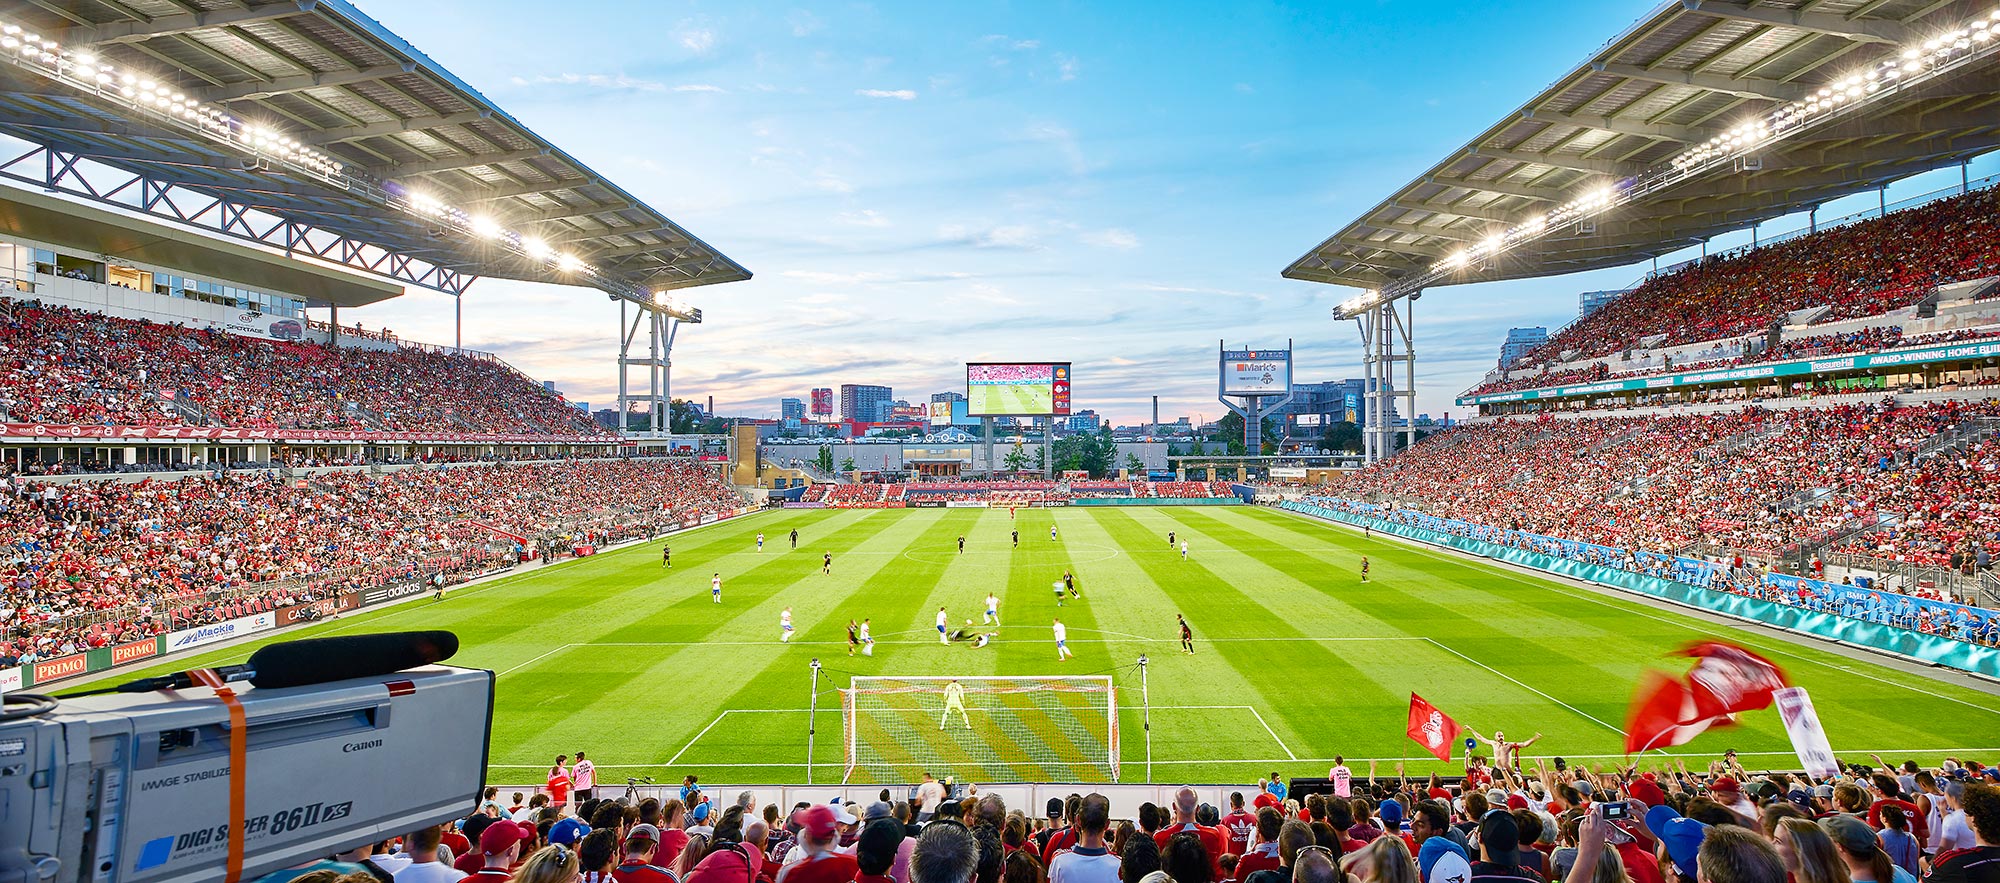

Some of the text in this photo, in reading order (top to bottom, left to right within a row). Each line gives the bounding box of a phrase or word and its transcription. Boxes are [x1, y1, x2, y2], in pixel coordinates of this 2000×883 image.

[226, 323, 264, 334] SPORTAGE
[1869, 349, 1946, 365] AWARD-WINNING
[1947, 346, 1977, 358] HOME
[1245, 363, 1276, 371] Mark's
[1682, 367, 1775, 383] AWARD-WINNING HOME BUILDER
[911, 433, 966, 443] FOOD
[387, 580, 421, 598] adidas
[1778, 578, 1796, 588] BMO
[1846, 591, 1867, 600] BMO
[197, 623, 235, 638] Mackie
[115, 642, 155, 660] PRIMO
[38, 659, 84, 679] PRIMO
[342, 739, 383, 753] Canon
[141, 776, 181, 792] IMAGE
[183, 766, 232, 784] STABILIZE
[175, 827, 214, 852] DIGI
[215, 815, 269, 842] SPER
[325, 803, 350, 822] XS
